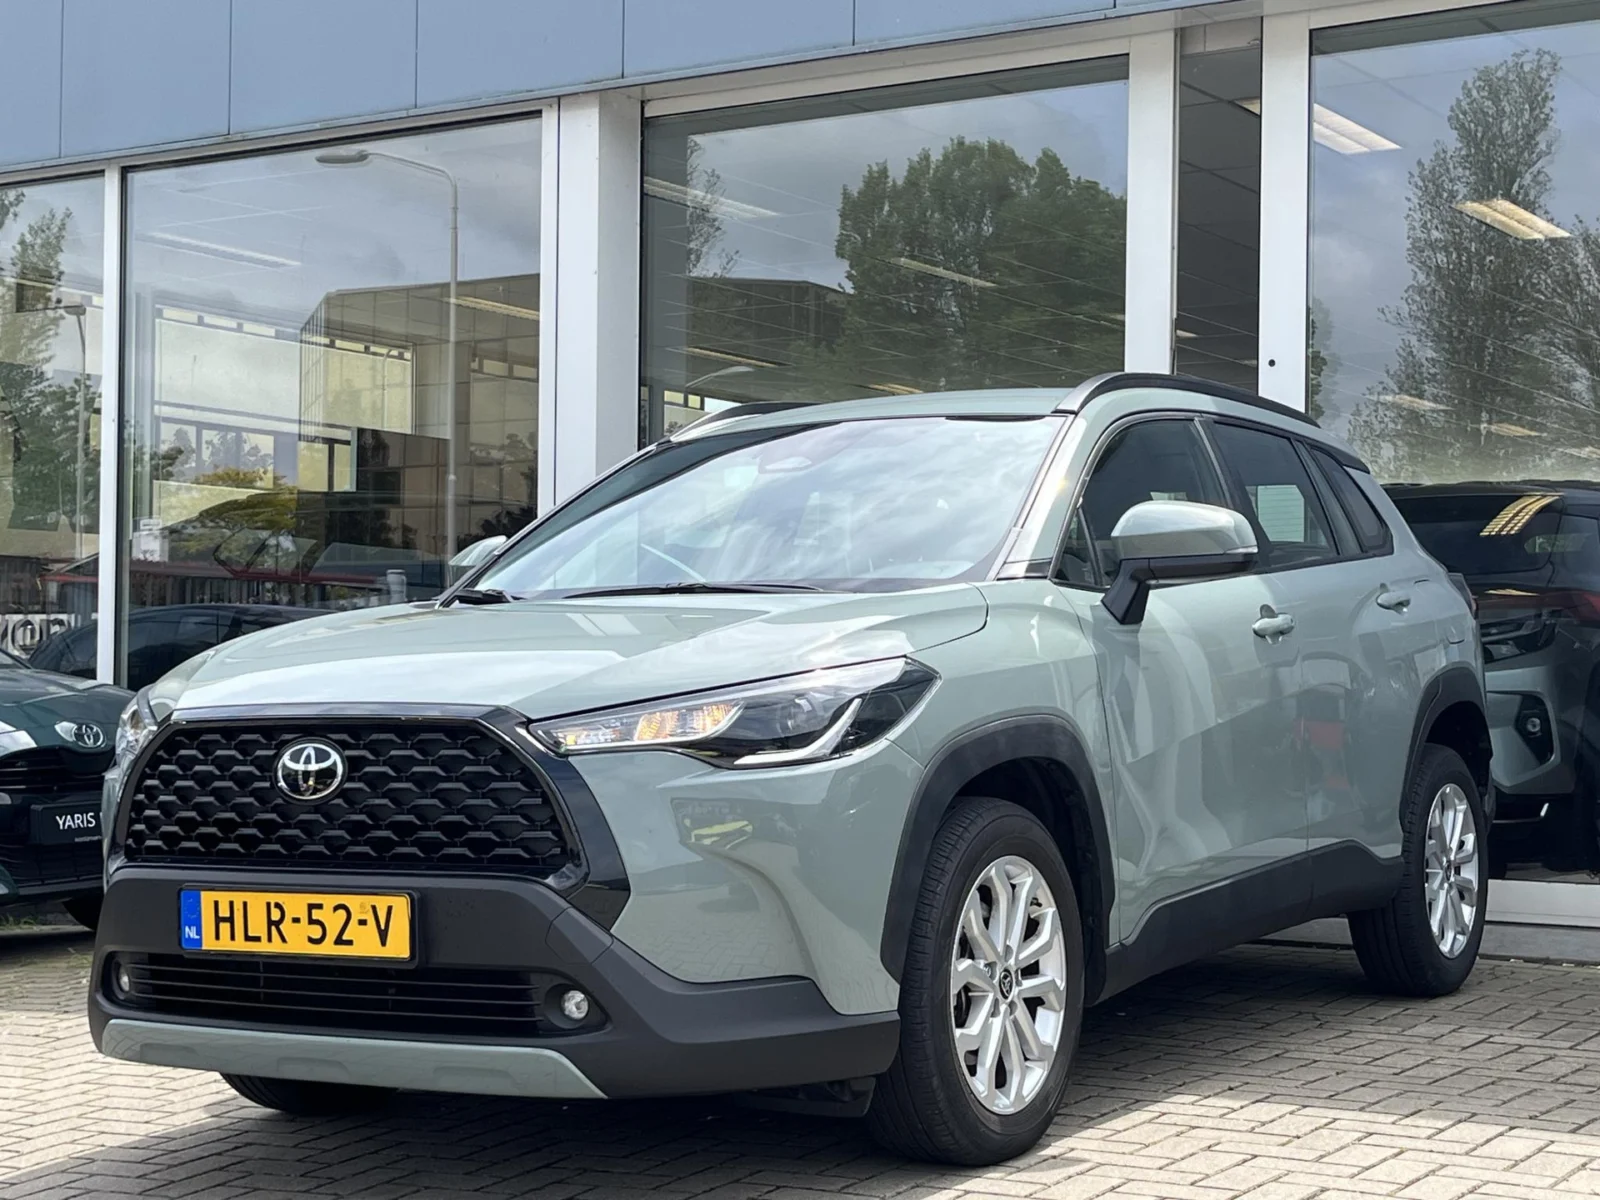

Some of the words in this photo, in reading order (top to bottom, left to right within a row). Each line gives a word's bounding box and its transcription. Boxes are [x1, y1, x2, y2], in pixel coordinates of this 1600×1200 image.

[55, 812, 96, 830] YARIS
[184, 925, 200, 939] NL
[213, 900, 394, 948] HLR-52-V
